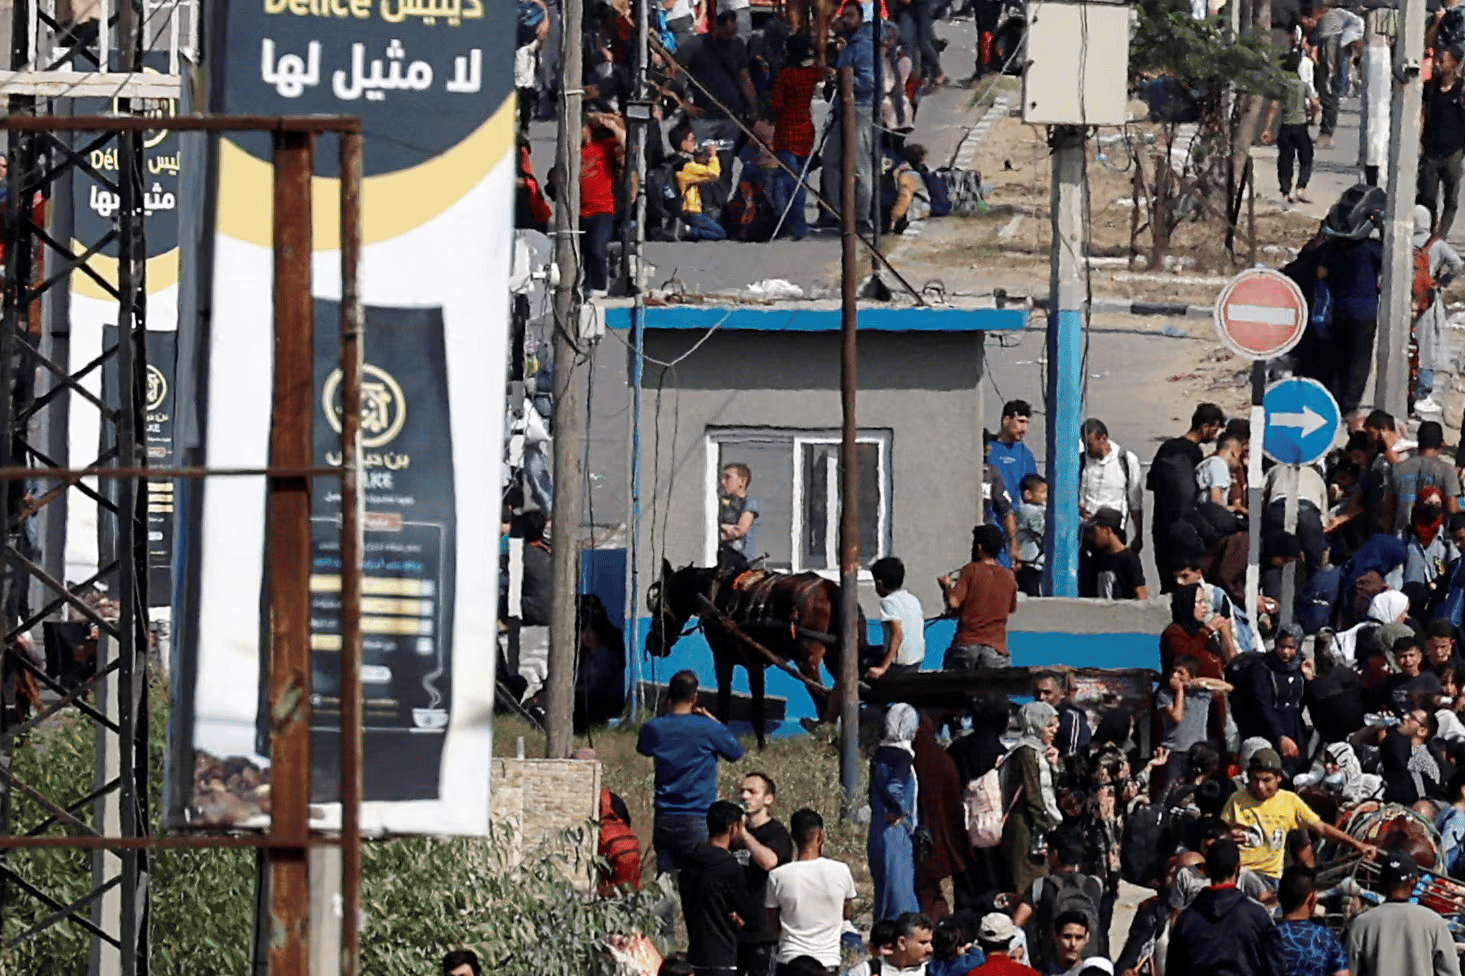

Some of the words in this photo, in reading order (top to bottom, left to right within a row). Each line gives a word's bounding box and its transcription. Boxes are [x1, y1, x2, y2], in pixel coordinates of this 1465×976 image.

[262, 38, 321, 98] لها
[332, 38, 433, 100] مثيل
[446, 48, 482, 93] لا
[90, 147, 119, 171] Dél
[143, 182, 175, 216] مثي
